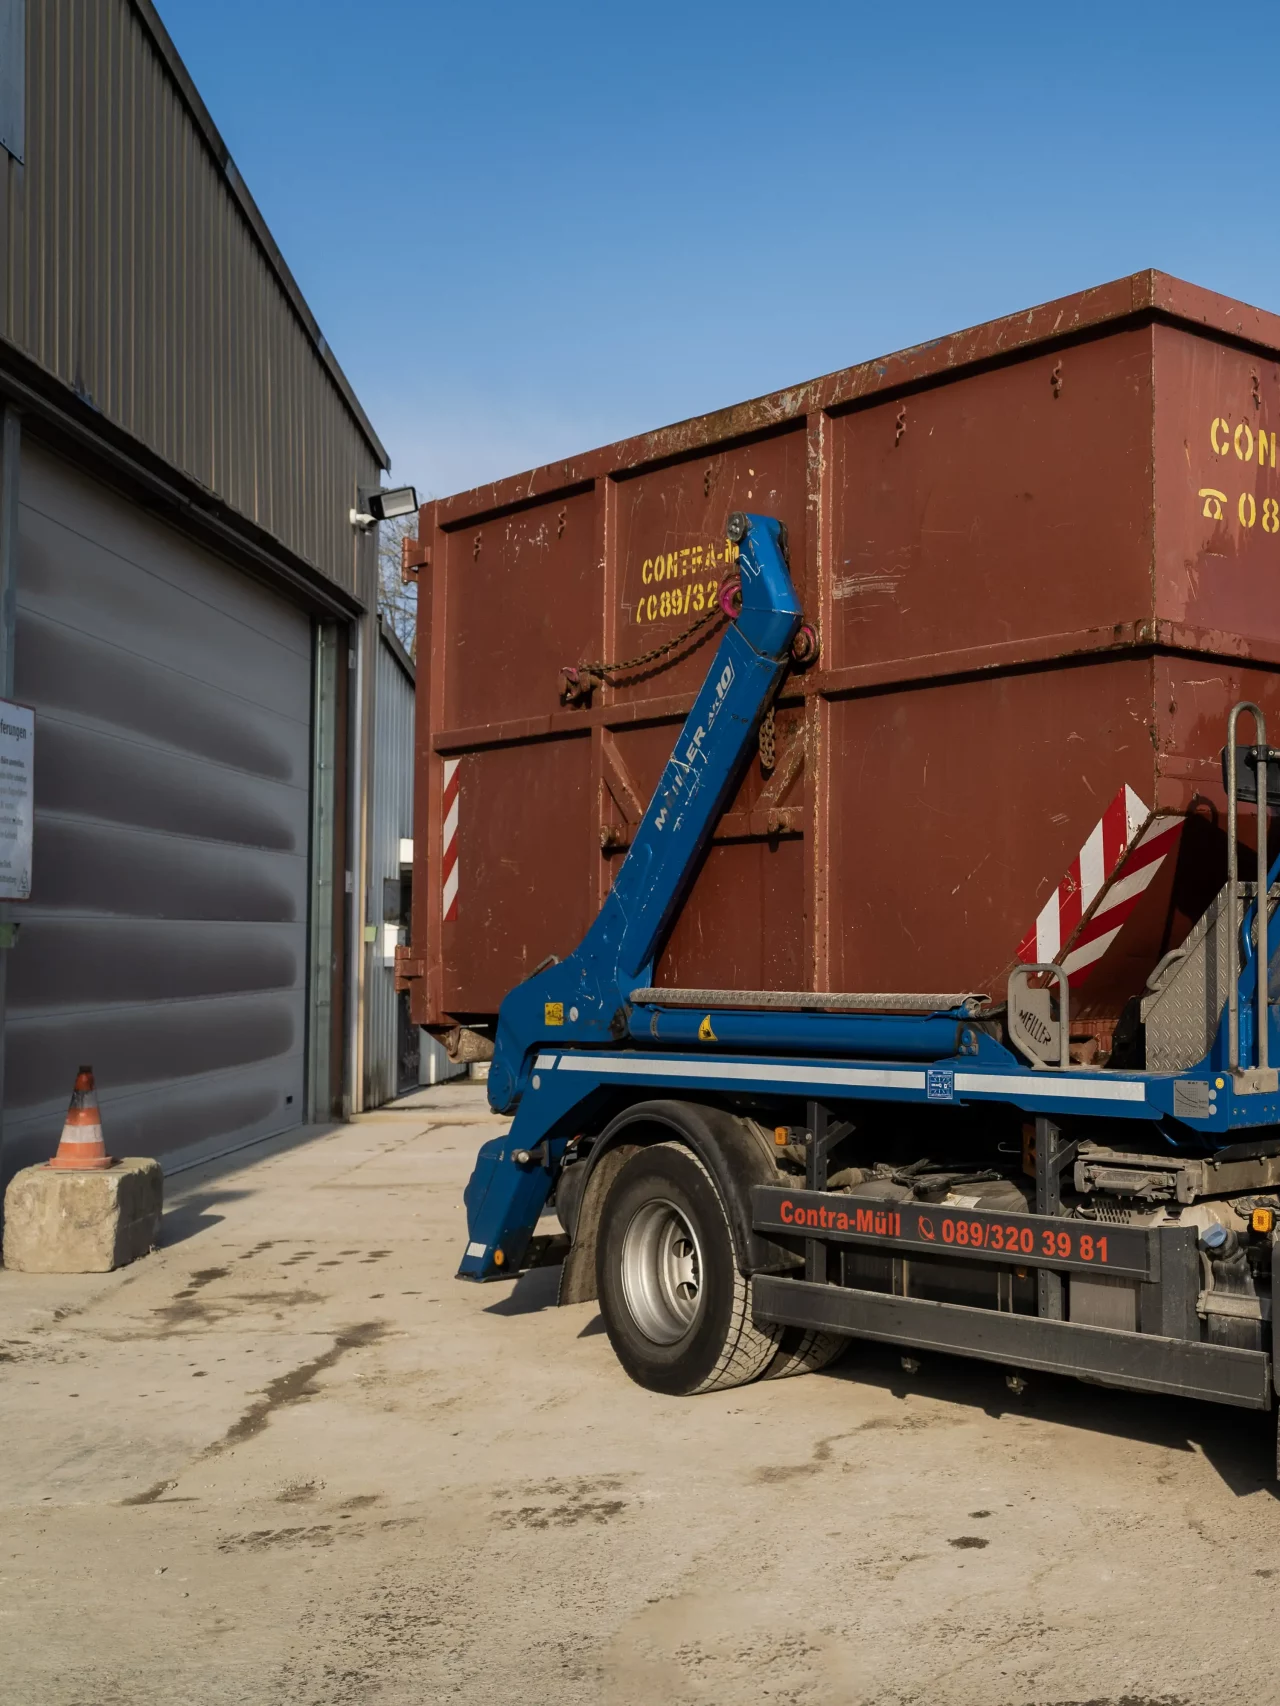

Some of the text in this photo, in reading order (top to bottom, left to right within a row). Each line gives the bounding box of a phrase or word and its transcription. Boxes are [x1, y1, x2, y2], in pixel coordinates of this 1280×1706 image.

[1019, 1009, 1051, 1045] MEILLER
[780, 1200, 1108, 1263] Contra-Müll 089/320 39 81
